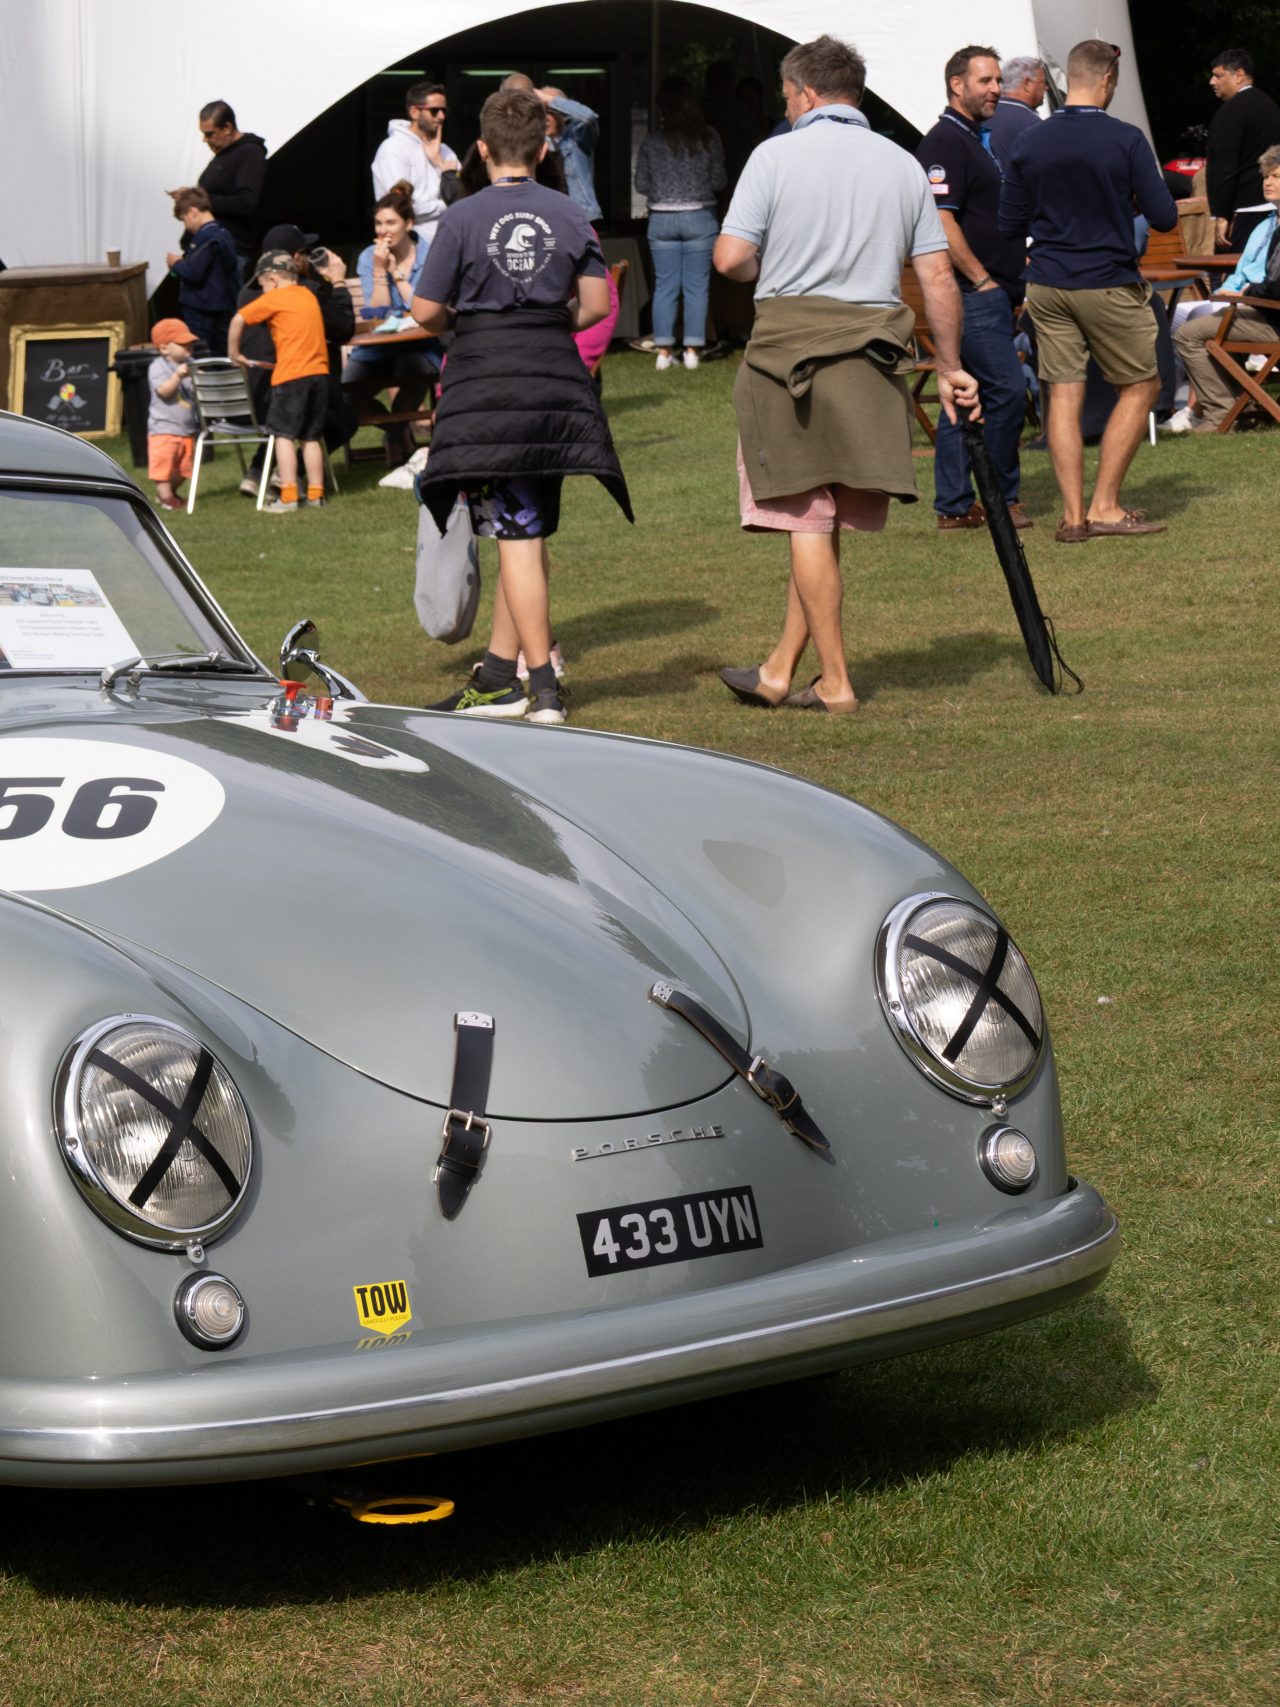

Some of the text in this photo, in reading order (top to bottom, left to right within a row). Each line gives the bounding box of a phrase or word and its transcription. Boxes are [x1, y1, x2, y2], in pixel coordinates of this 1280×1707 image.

[514, 212, 535, 220] SURF
[507, 258, 535, 271] OCEAN
[40, 358, 90, 382] Bar
[571, 1125, 726, 1162] PORSCHE
[592, 1194, 757, 1264] 433 UYN
[356, 1282, 407, 1318] TOW
